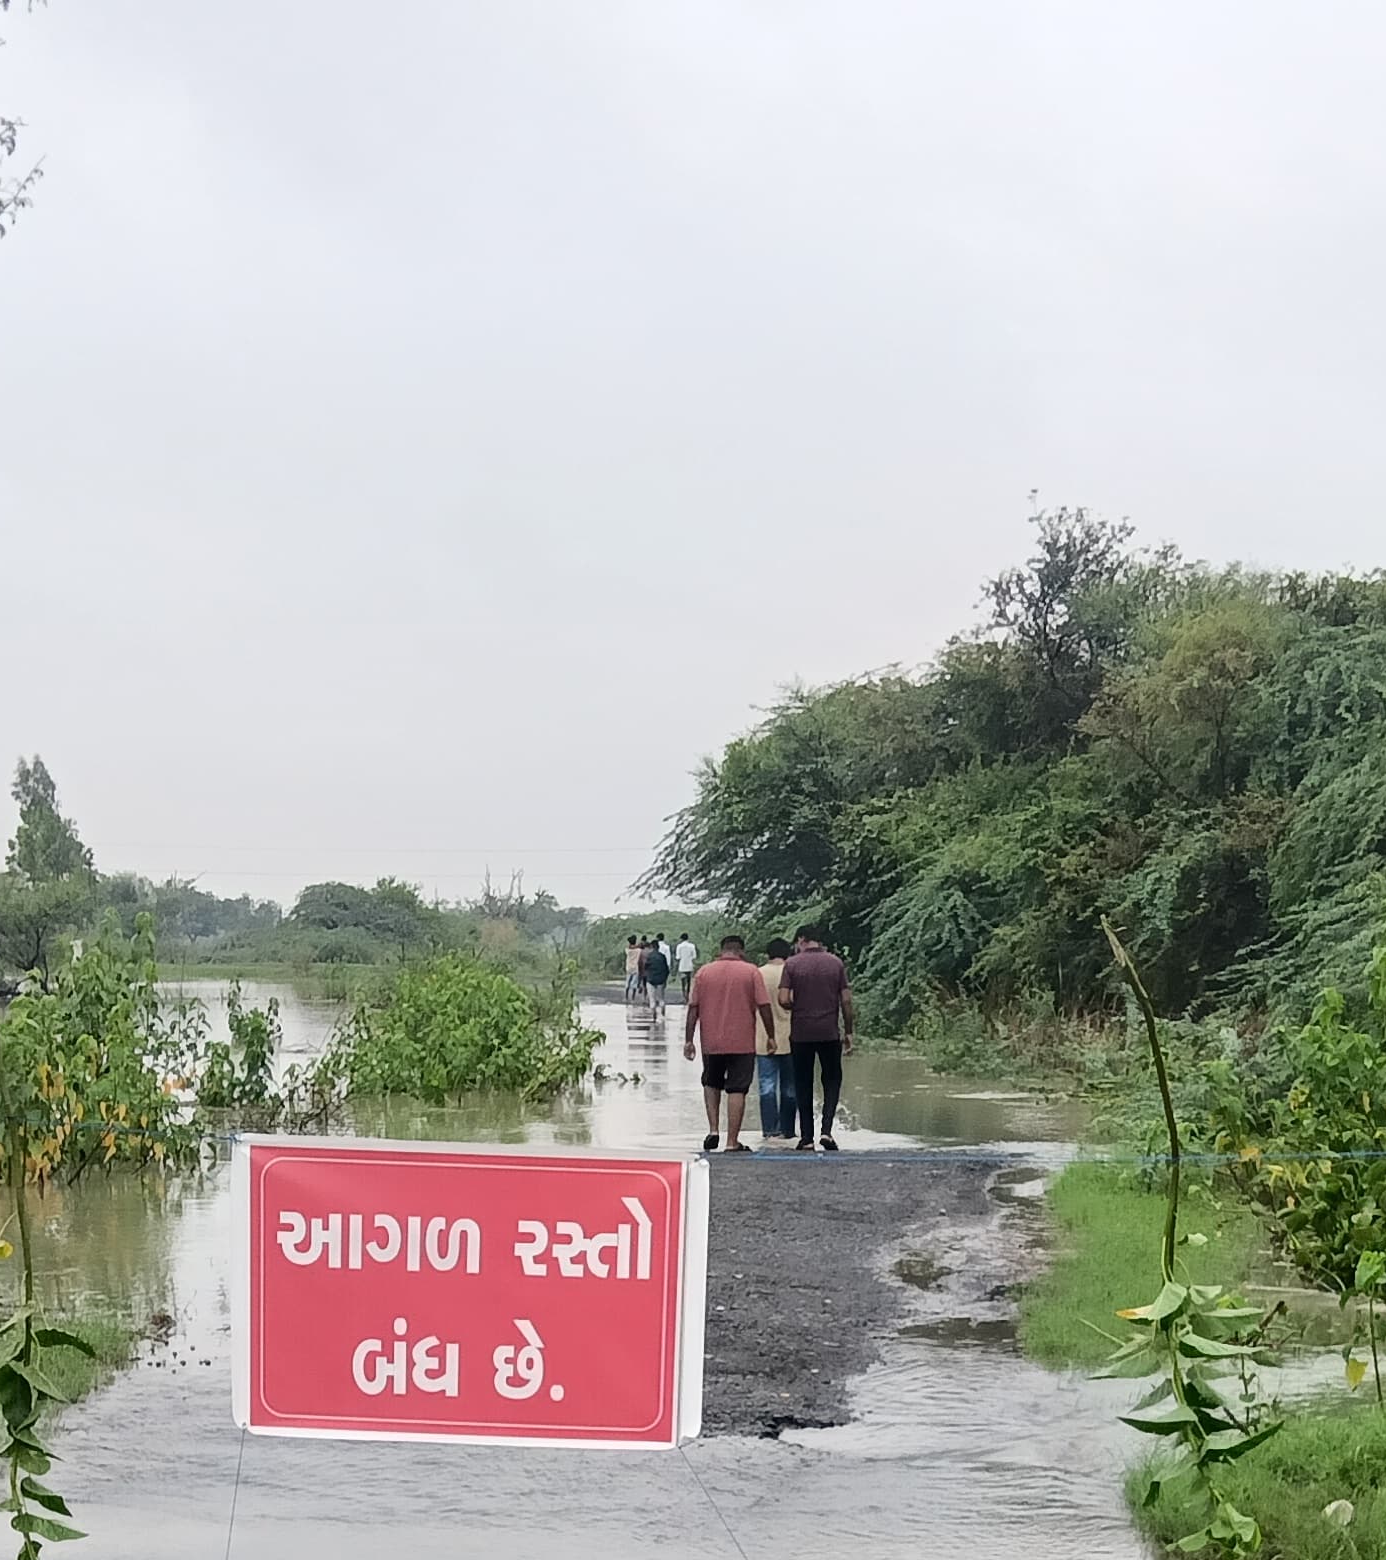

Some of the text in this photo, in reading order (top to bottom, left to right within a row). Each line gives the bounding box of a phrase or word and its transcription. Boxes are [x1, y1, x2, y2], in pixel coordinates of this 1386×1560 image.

[277, 1196, 653, 1280] આગળ રસ્તો
[352, 1317, 565, 1402] બંધ છે.
